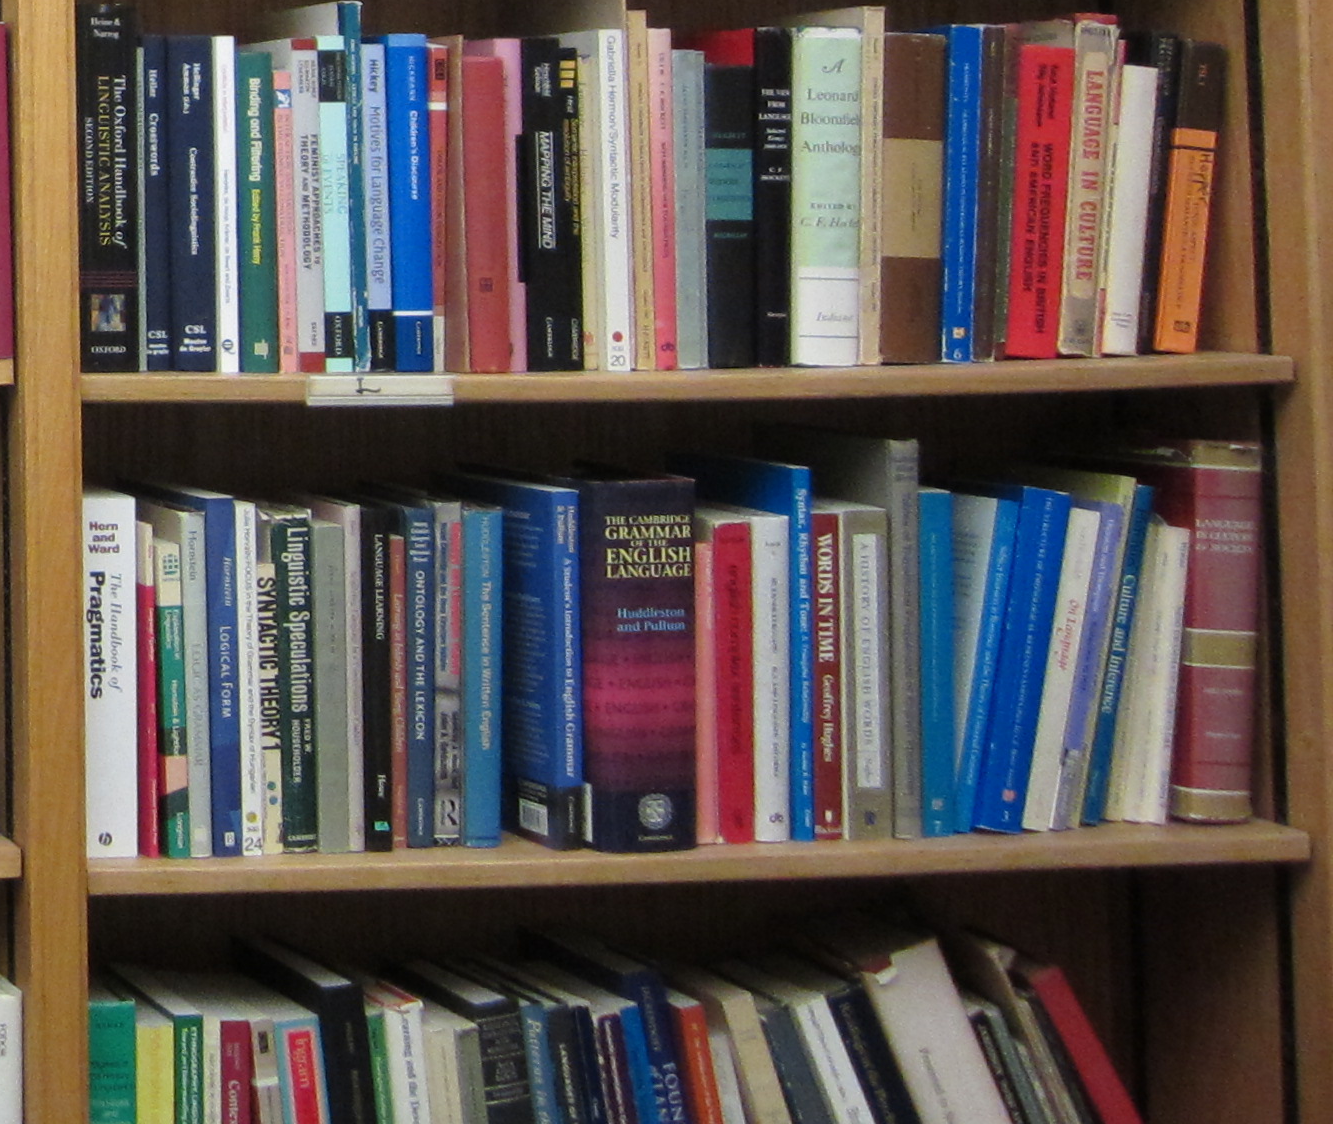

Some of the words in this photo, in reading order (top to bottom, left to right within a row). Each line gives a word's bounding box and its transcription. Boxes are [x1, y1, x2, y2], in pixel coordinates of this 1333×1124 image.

[113, 75, 127, 102] The
[98, 76, 112, 168] LINGUISTIC
[113, 105, 127, 153] Oxford
[1082, 70, 1105, 159] LANGUAGE
[113, 156, 127, 228] Handbook
[1082, 171, 1102, 190] IN
[98, 171, 112, 246] ANALYSIS
[112, 232, 127, 248] of
[1075, 201, 1101, 281] CULTURE
[89, 521, 119, 531] Horn
[93, 534, 115, 543] and
[604, 526, 692, 540] GRAMMAR
[88, 544, 120, 554] Ward
[281, 527, 308, 607] Linguistic
[604, 565, 692, 578] LANGUAGE
[605, 547, 691, 564] ENGLISH
[817, 533, 833, 594] WORDS
[109, 573, 122, 599] The
[818, 598, 833, 616] IN
[87, 571, 106, 699] Pragmatics
[257, 577, 278, 671] SYNTACTIC
[616, 608, 685, 618] Huddleston
[108, 602, 123, 675] Handbook
[219, 626, 233, 678] LOGICAL
[818, 619, 834, 662] TIME
[284, 611, 309, 713] Speculations
[107, 678, 124, 694] of
[220, 682, 234, 718] FORM
[260, 676, 279, 738] THEORY
[293, 1036, 313, 1088] Ingram
